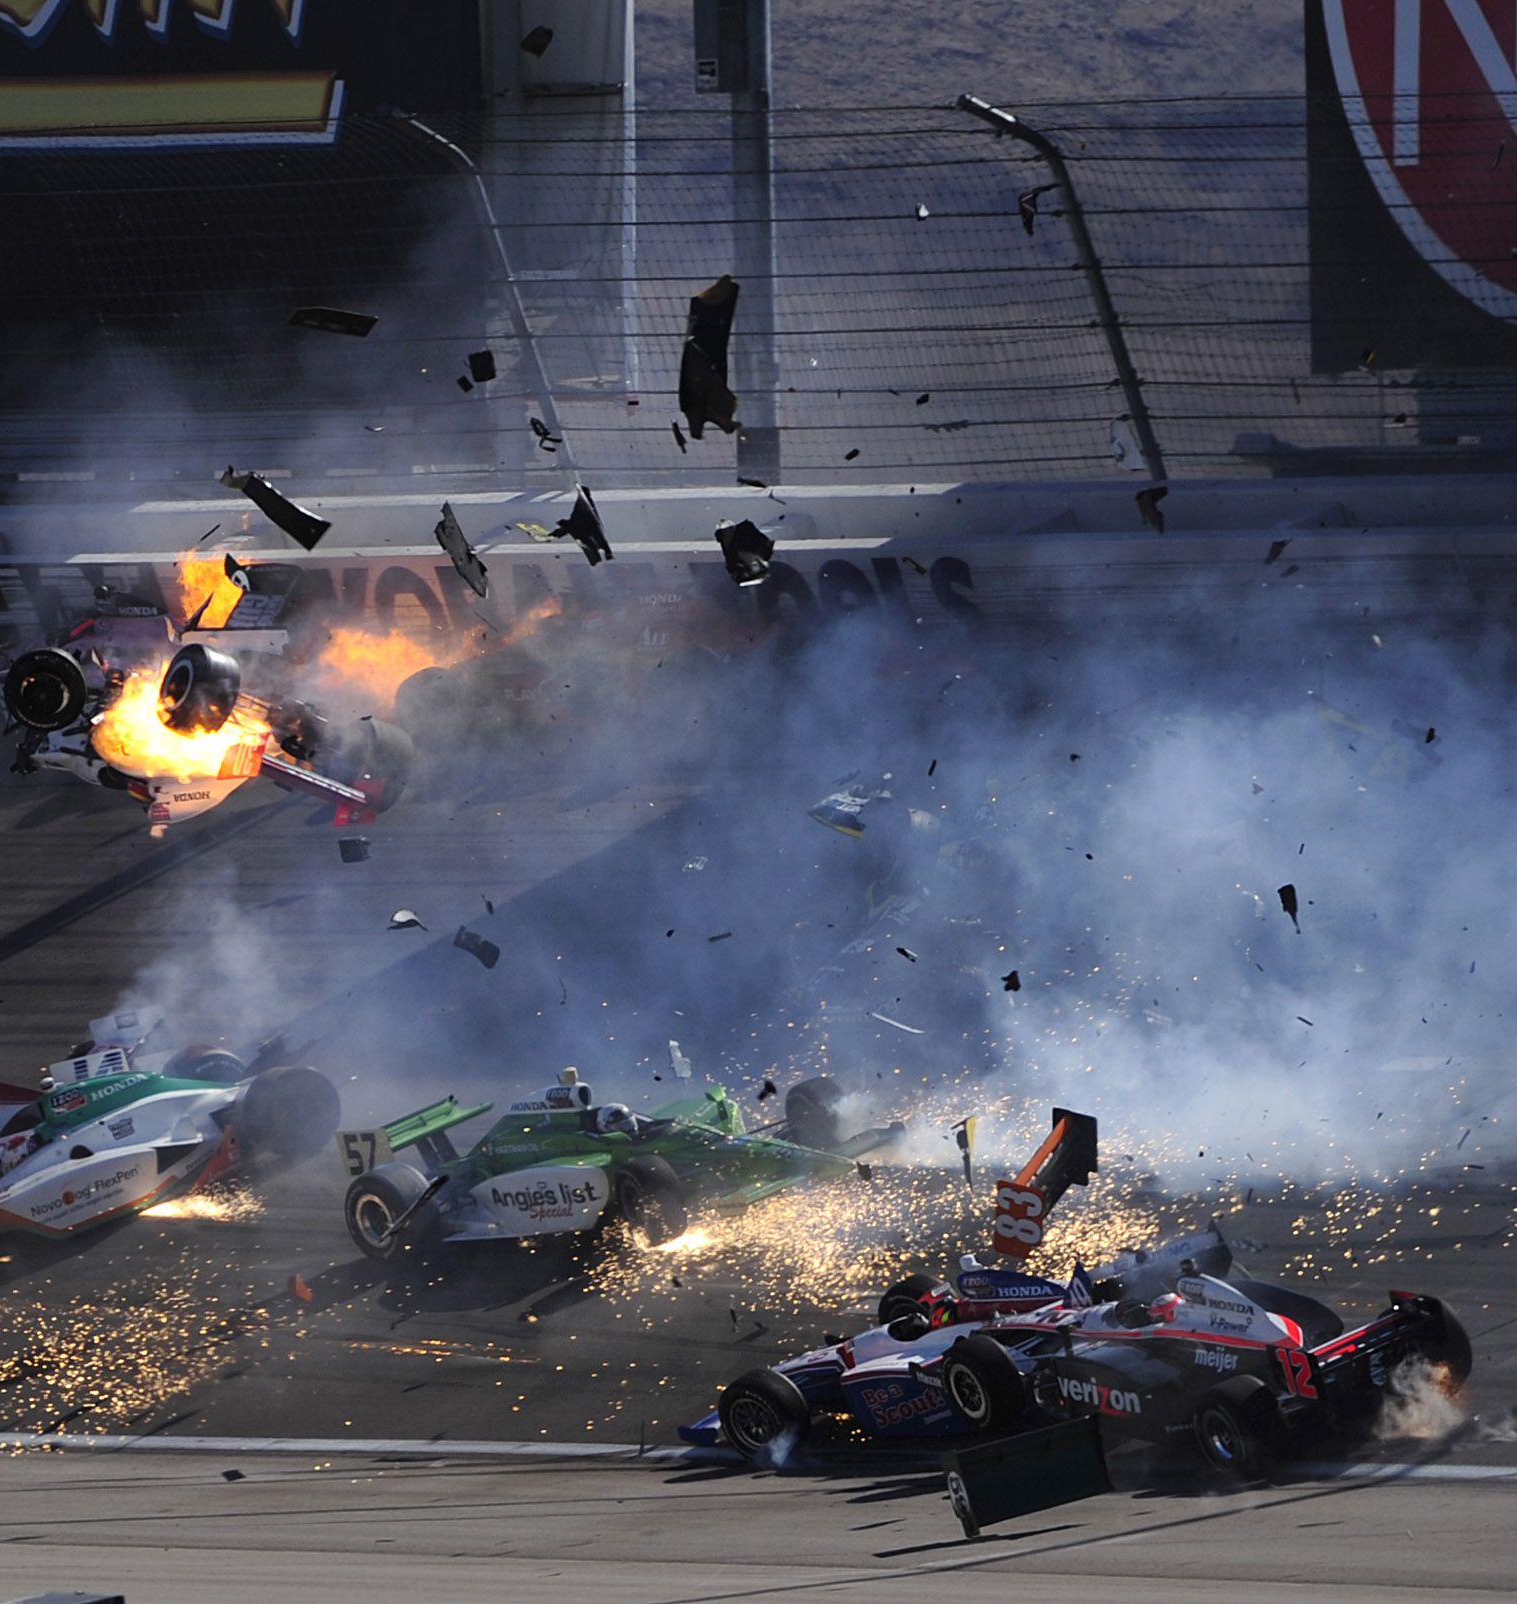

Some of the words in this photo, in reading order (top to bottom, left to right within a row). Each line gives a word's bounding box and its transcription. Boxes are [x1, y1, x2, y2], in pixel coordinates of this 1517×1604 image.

[118, 606, 159, 617] HONDA
[172, 789, 211, 803] HONDA
[90, 1073, 150, 1101] HONDA
[509, 1101, 549, 1112] HONDA
[343, 1132, 376, 1176] 57
[30, 1185, 91, 1217] Novoog
[94, 1167, 140, 1193] FlexPen
[558, 1181, 602, 1209] list
[529, 1204, 574, 1221] Special
[995, 1187, 1043, 1245] 83
[997, 1285, 1053, 1298] HONDA
[1208, 1298, 1255, 1316] HONDA
[1209, 1312, 1251, 1333] V-Power
[1194, 1345, 1239, 1374] meijer
[1275, 1347, 1319, 1400] 12
[861, 1388, 889, 1406] Be
[888, 1384, 904, 1398] a
[1056, 1376, 1142, 1417] verizon
